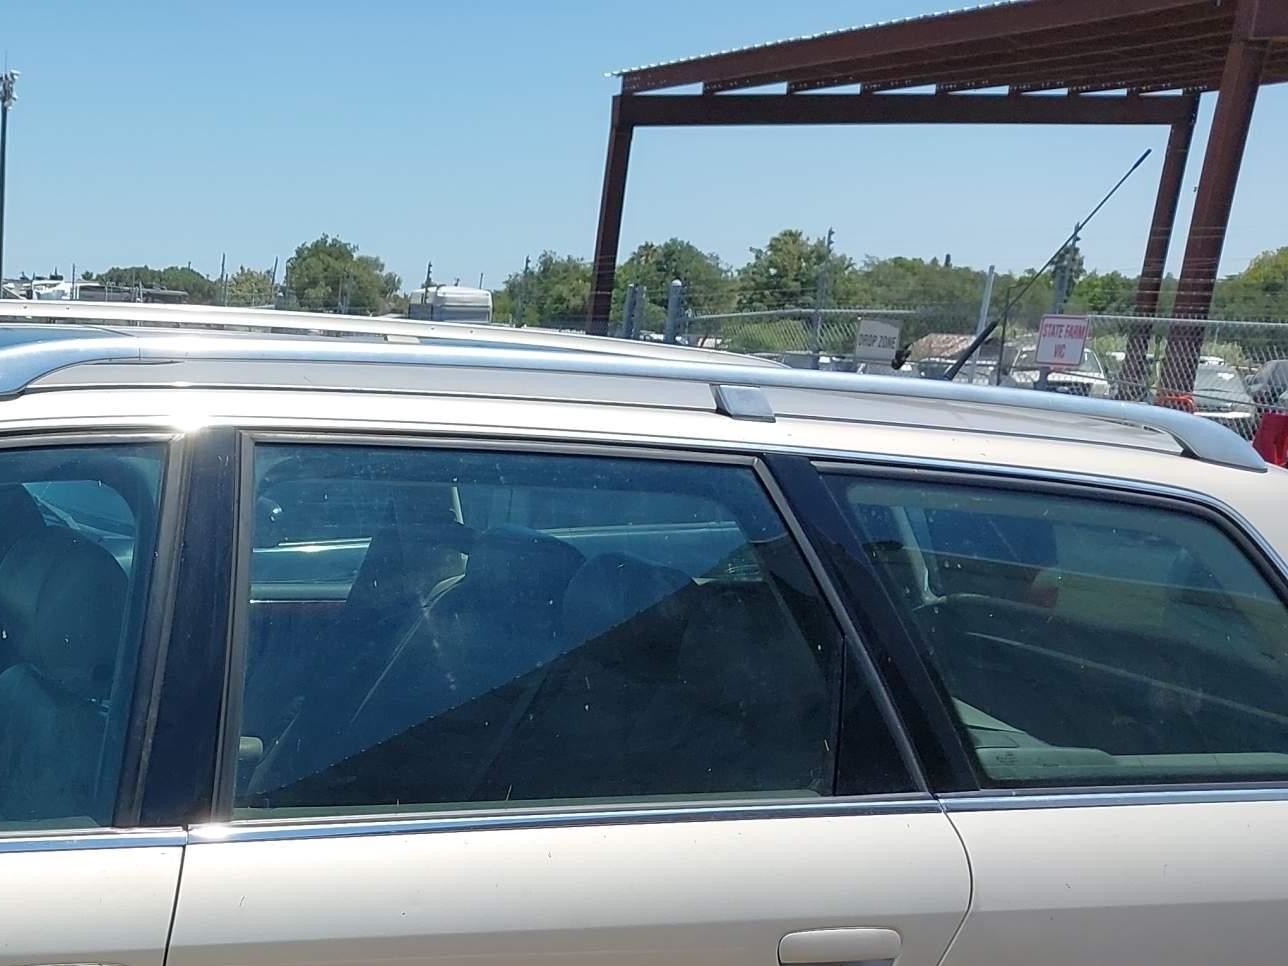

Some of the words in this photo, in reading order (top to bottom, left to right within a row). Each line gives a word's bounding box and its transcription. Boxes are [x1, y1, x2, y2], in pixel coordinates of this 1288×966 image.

[1042, 323, 1065, 338] STATE
[1064, 324, 1088, 339] FARM
[858, 333, 878, 347] DROP
[878, 335, 897, 350] ZONE
